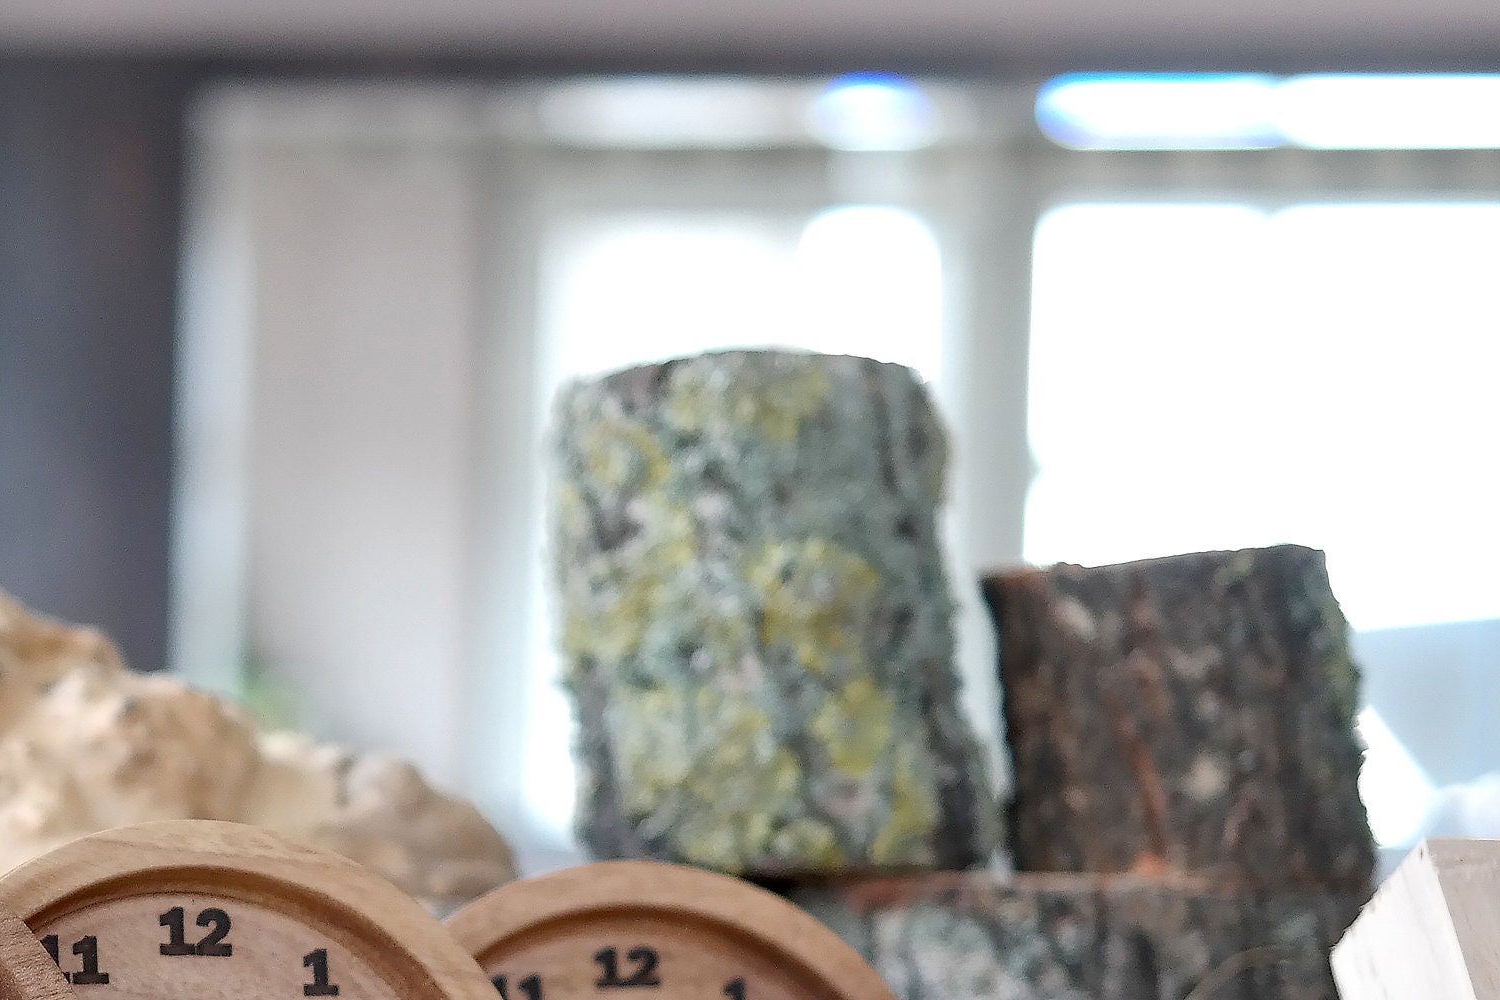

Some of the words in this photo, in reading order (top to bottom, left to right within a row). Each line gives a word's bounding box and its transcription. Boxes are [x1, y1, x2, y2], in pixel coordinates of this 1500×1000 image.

[159, 907, 232, 957] 12
[304, 949, 339, 996] 1
[595, 946, 660, 988] 12
